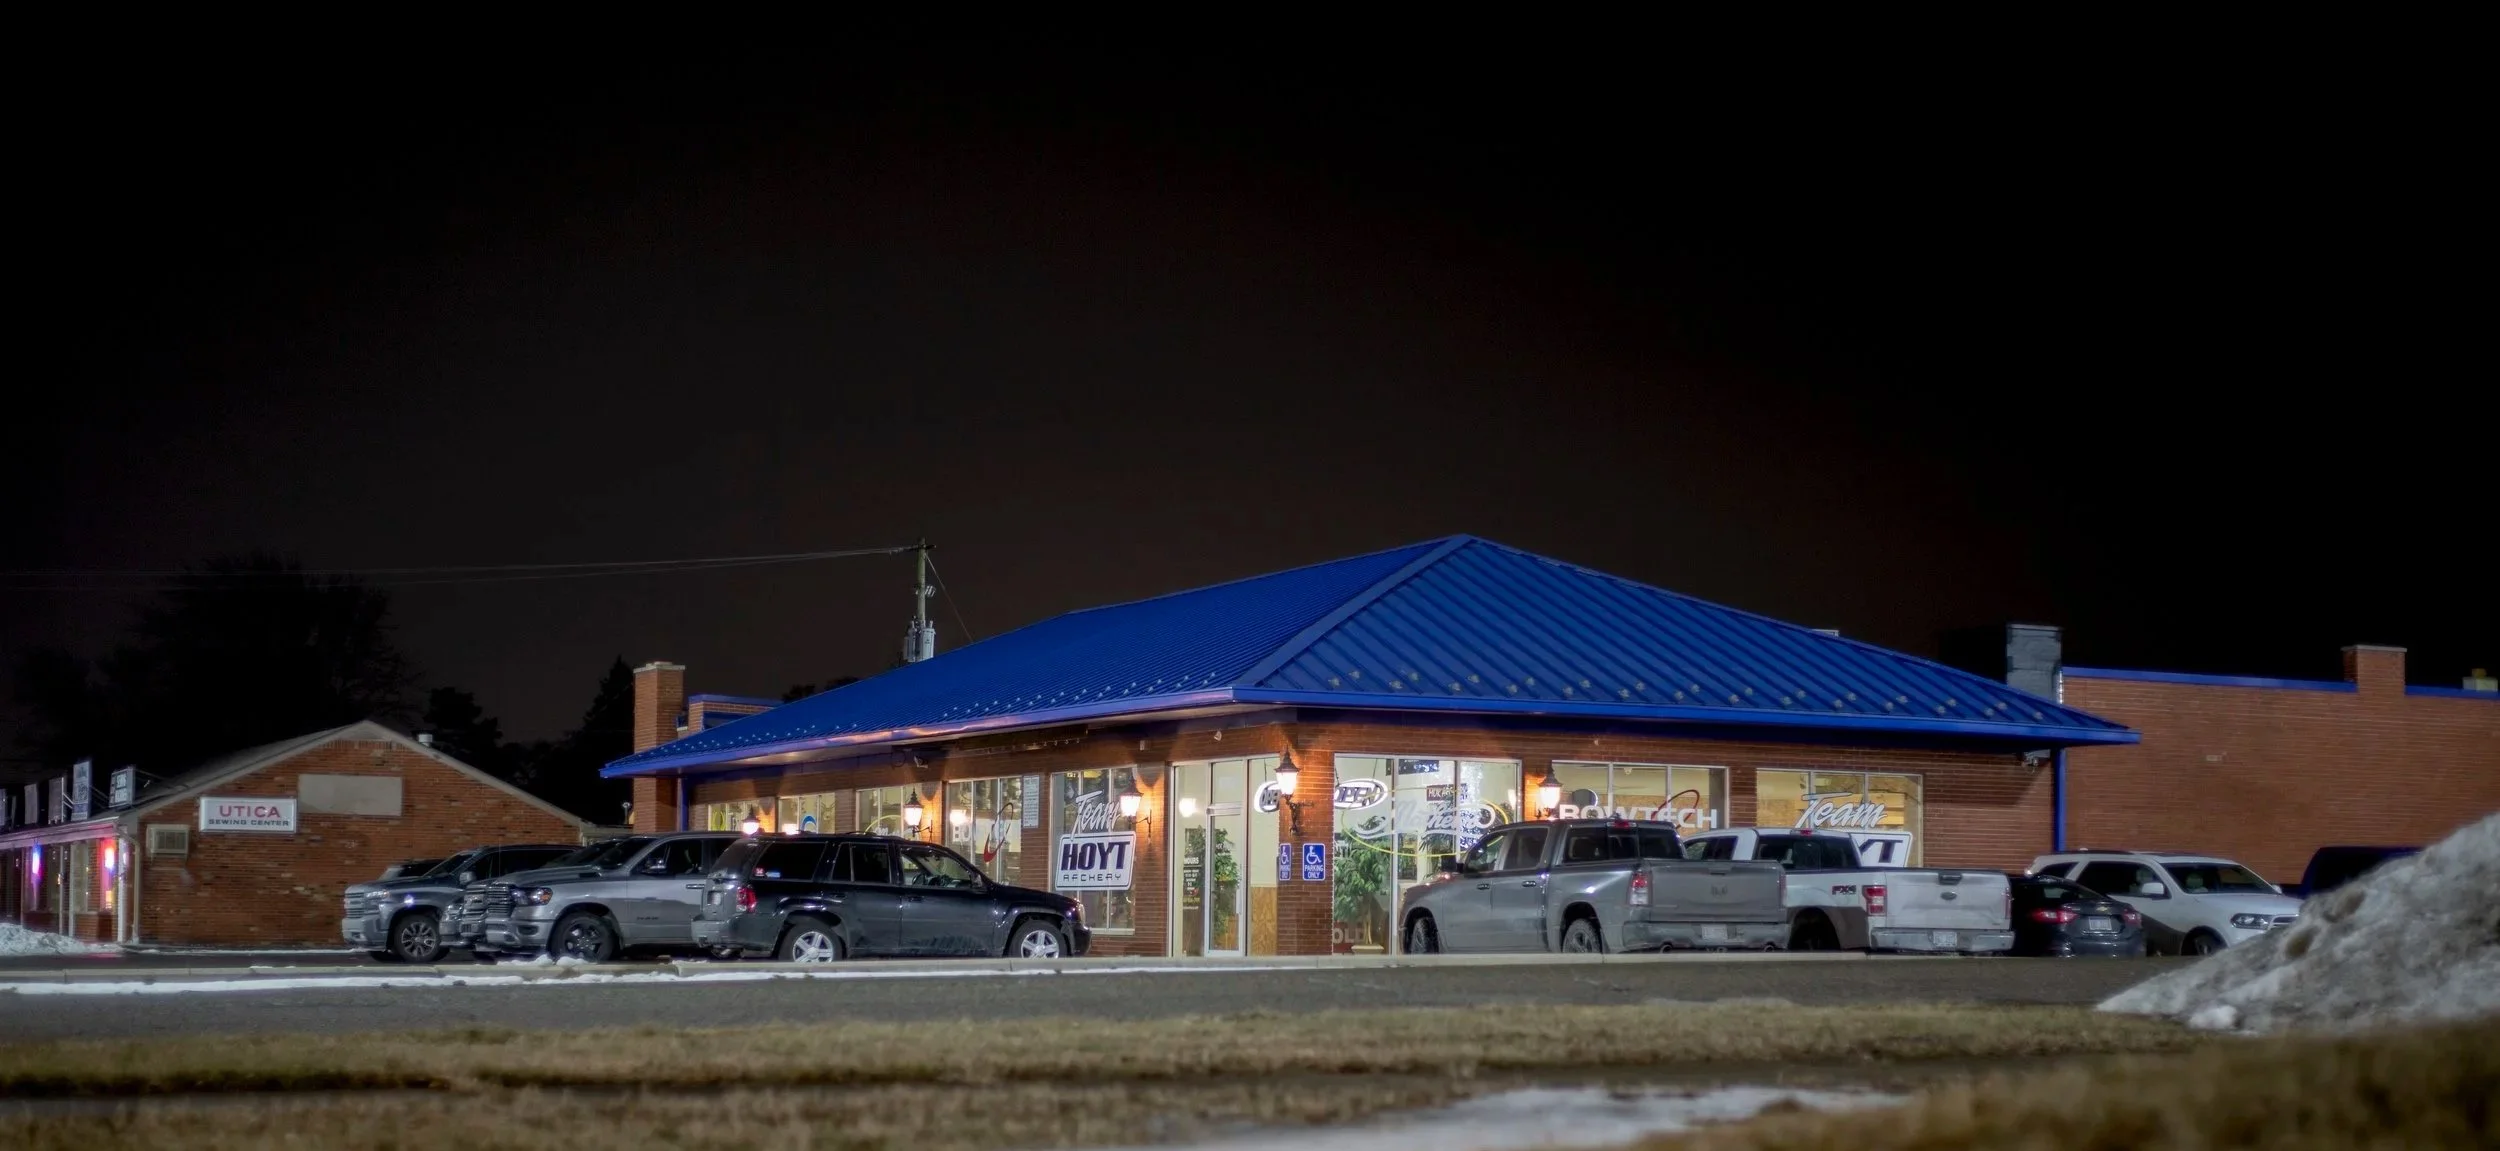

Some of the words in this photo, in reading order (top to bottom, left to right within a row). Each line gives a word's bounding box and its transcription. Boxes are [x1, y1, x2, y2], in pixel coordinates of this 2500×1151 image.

[219, 805, 281, 818] UTICA
[1070, 789, 1121, 842] Team
[1559, 803, 1718, 829] BOWTECH
[1795, 791, 1888, 829] Team
[1060, 841, 1131, 871] HOYT
[1304, 864, 1324, 872] PARKING
[1307, 871, 1320, 879] ONLY
